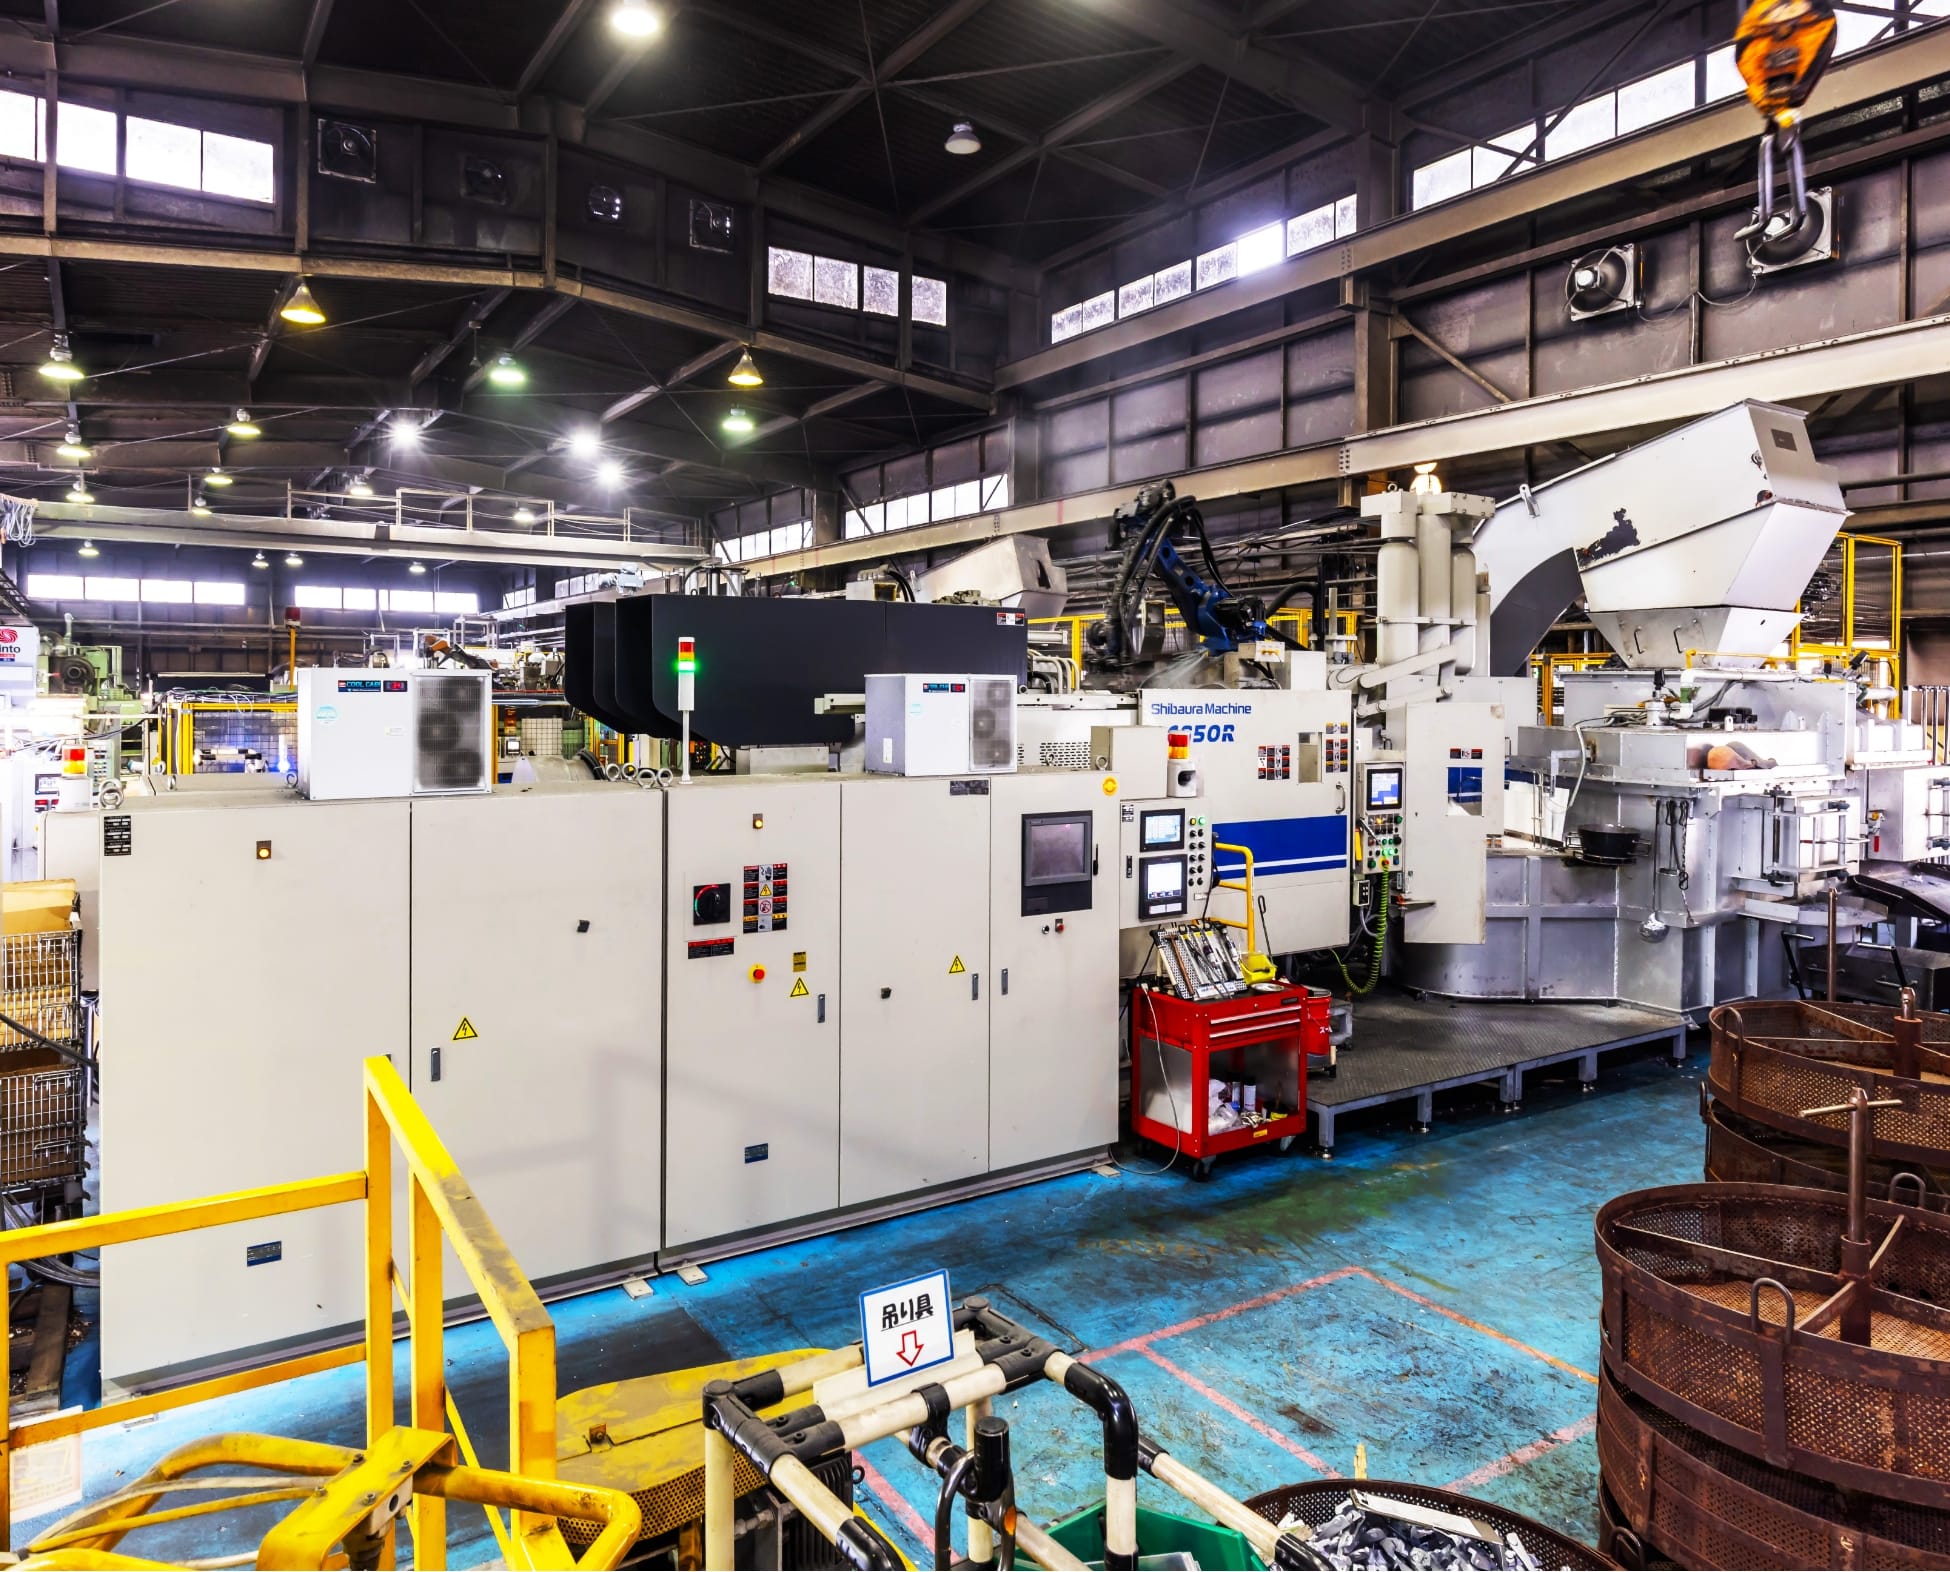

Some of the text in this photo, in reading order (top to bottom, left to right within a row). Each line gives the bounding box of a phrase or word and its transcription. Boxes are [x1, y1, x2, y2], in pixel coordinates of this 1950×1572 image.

[1151, 702, 1252, 715] Shibaura Machine
[882, 1293, 934, 1329] 吊り具
